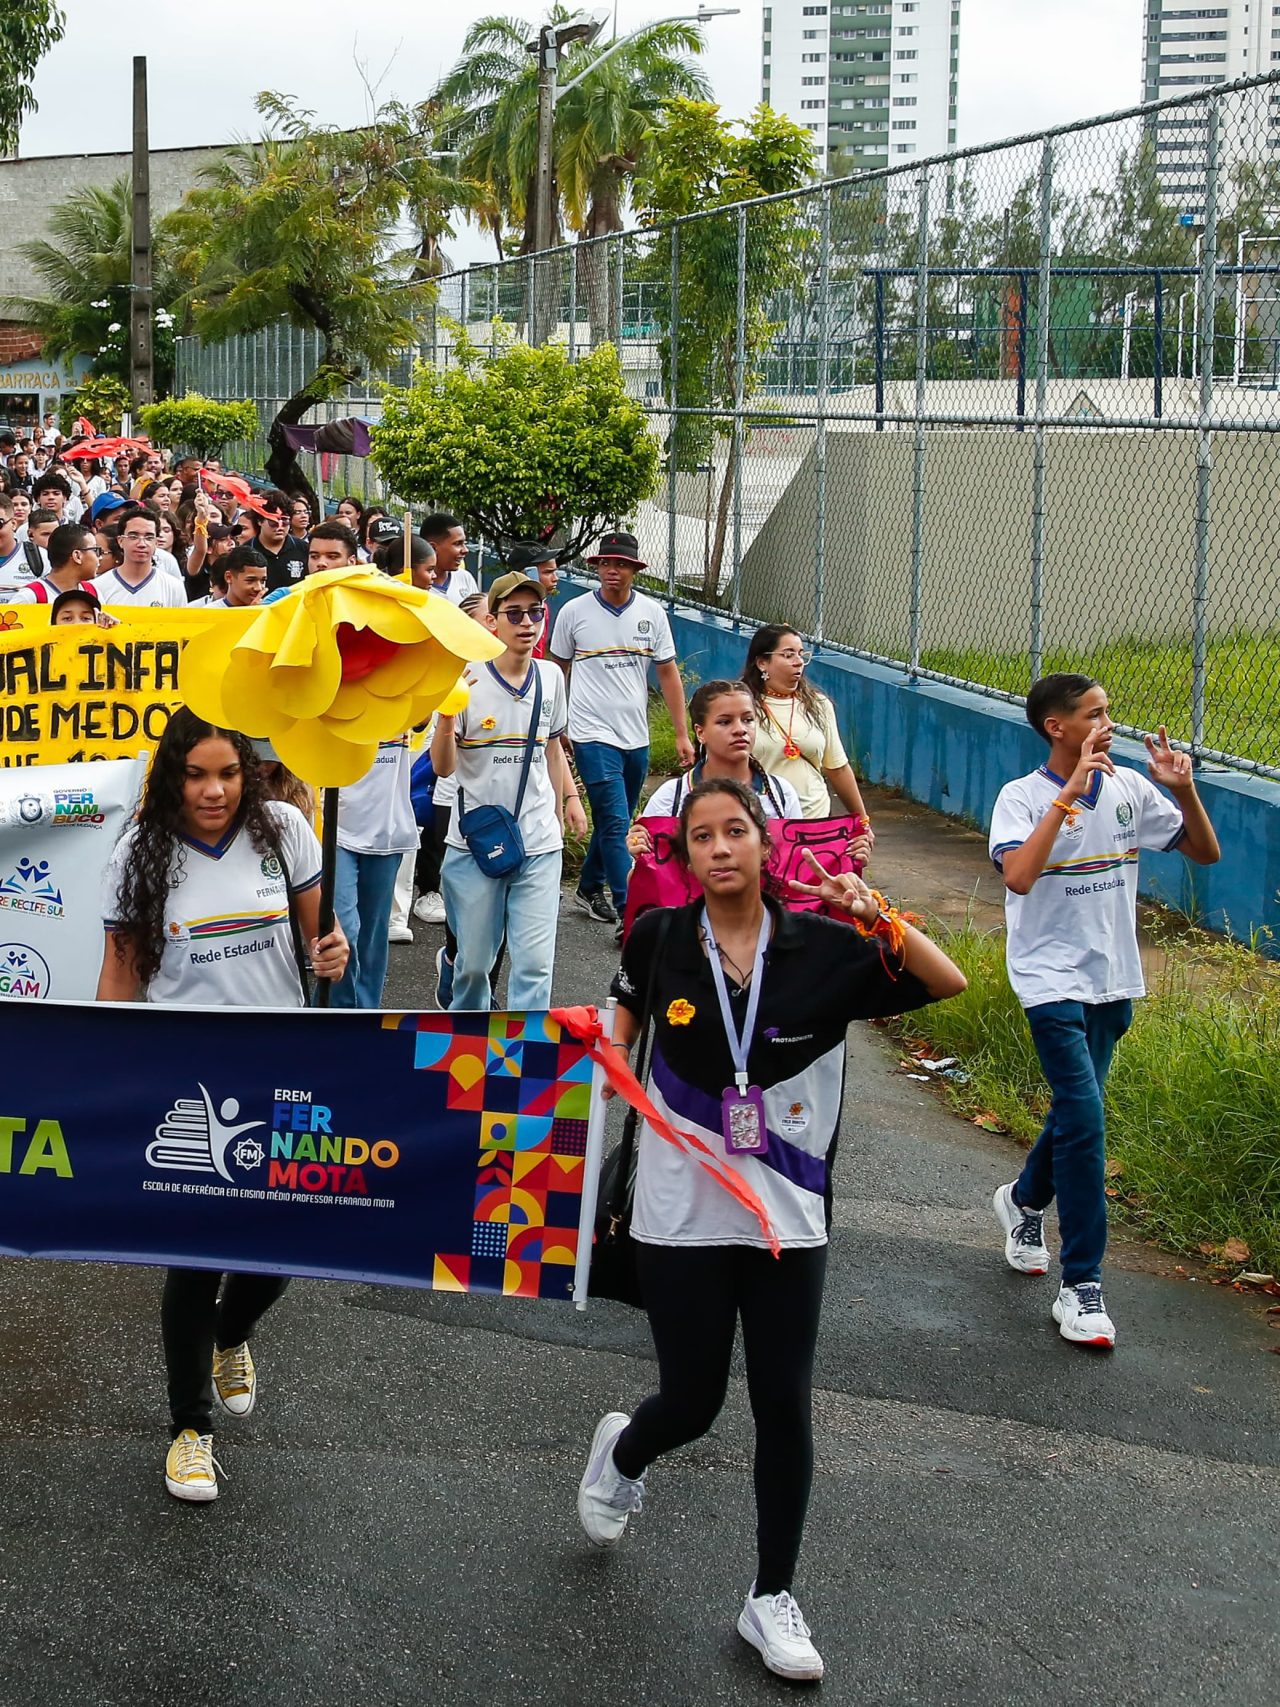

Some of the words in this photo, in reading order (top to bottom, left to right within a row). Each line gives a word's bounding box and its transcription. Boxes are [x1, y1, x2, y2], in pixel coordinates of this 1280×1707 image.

[78, 640, 189, 691] INFA
[492, 755, 512, 765] Rede
[54, 792, 95, 805] PER
[52, 812, 106, 825] BUCO
[55, 804, 99, 816] NAM
[1065, 884, 1091, 897] Rede
[11, 898, 46, 915] RECIFE
[47, 904, 66, 919] SUL
[190, 949, 222, 965] Rede
[223, 937, 275, 960] Estadual
[274, 1088, 312, 1103] EREM
[272, 1102, 333, 1134] FER
[239, 1148, 258, 1161] FM
[270, 1130, 400, 1169] NANDO
[268, 1160, 369, 1195] MOTA
[142, 1180, 170, 1192] ESCOLA
[171, 1182, 182, 1193] DE
[182, 1183, 226, 1197] REFERÊNCIA
[226, 1187, 239, 1198] EM
[239, 1188, 266, 1200] ENSINO
[266, 1188, 291, 1202] MÉDIO
[291, 1193, 334, 1205] PROFESSOR
[334, 1196, 372, 1208] FERNANDO
[373, 1199, 395, 1209] MOTA
